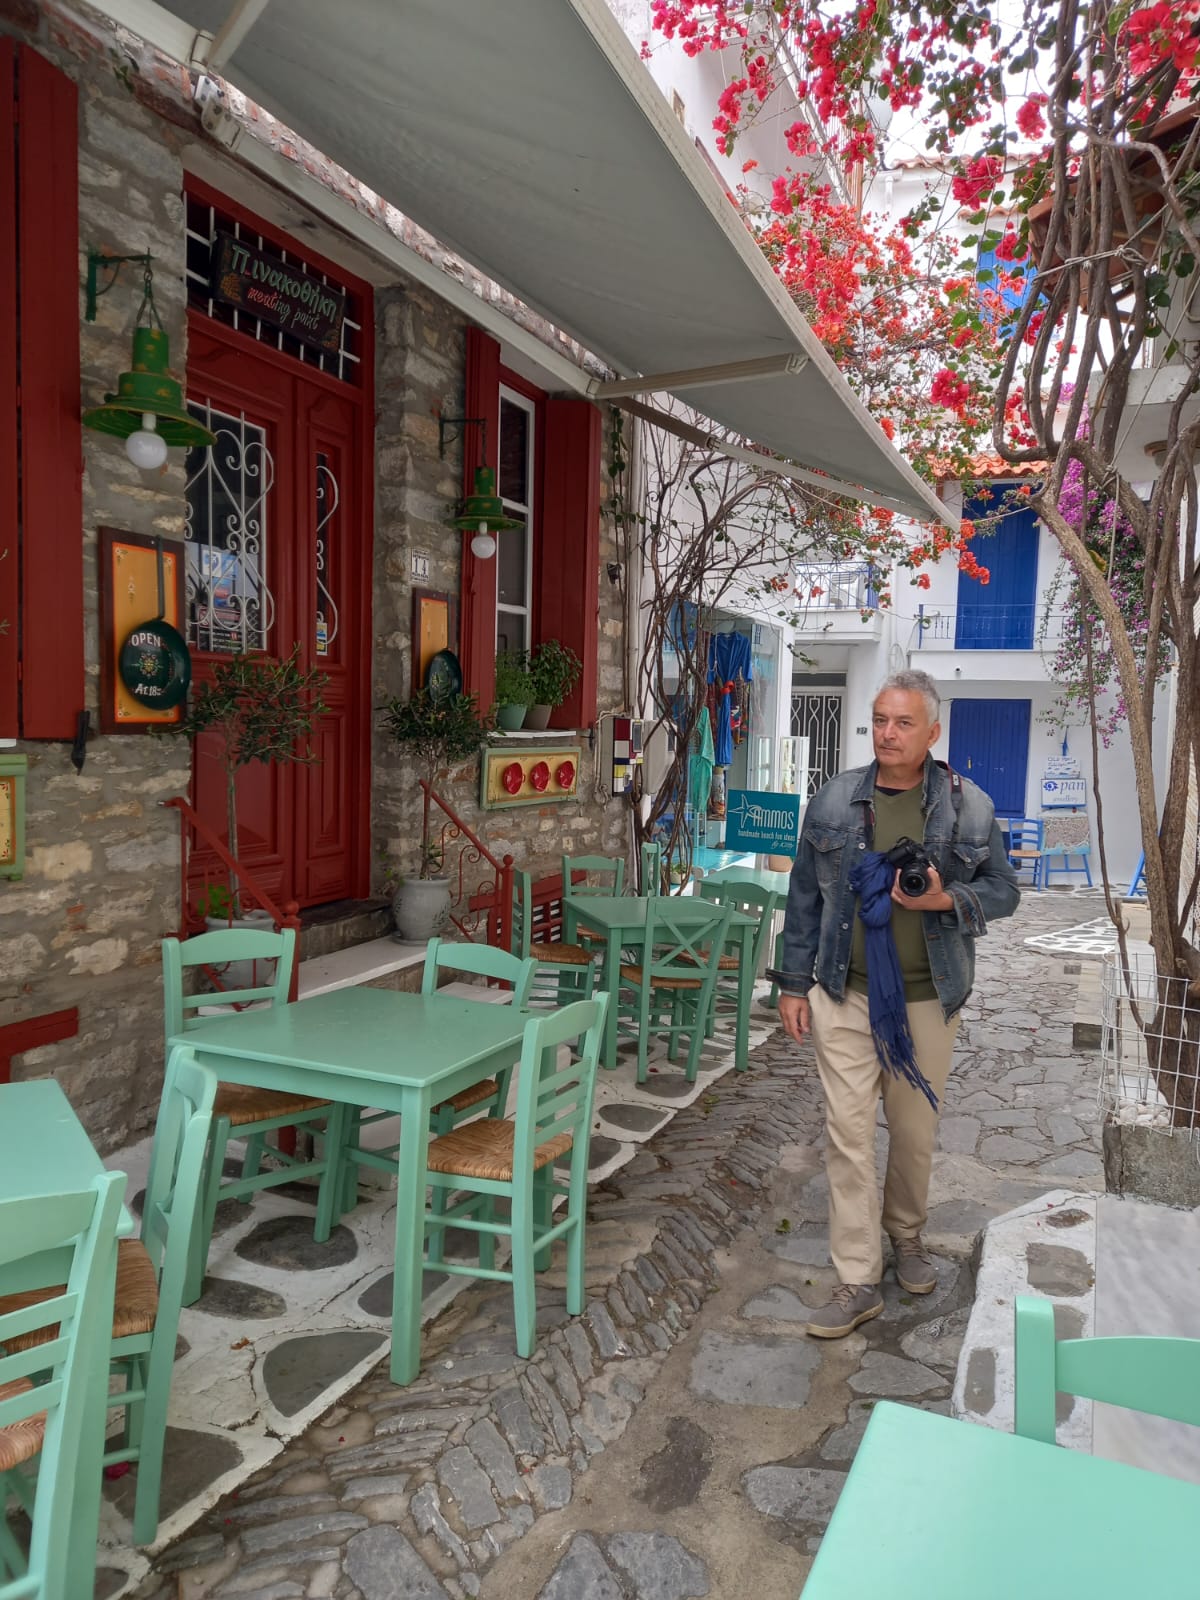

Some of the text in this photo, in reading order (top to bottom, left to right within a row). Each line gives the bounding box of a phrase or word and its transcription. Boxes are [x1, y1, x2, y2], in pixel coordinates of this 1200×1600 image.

[231, 243, 337, 323] Πινακοθήκη
[131, 632, 161, 648] OPEN
[1060, 781, 1085, 795] pan
